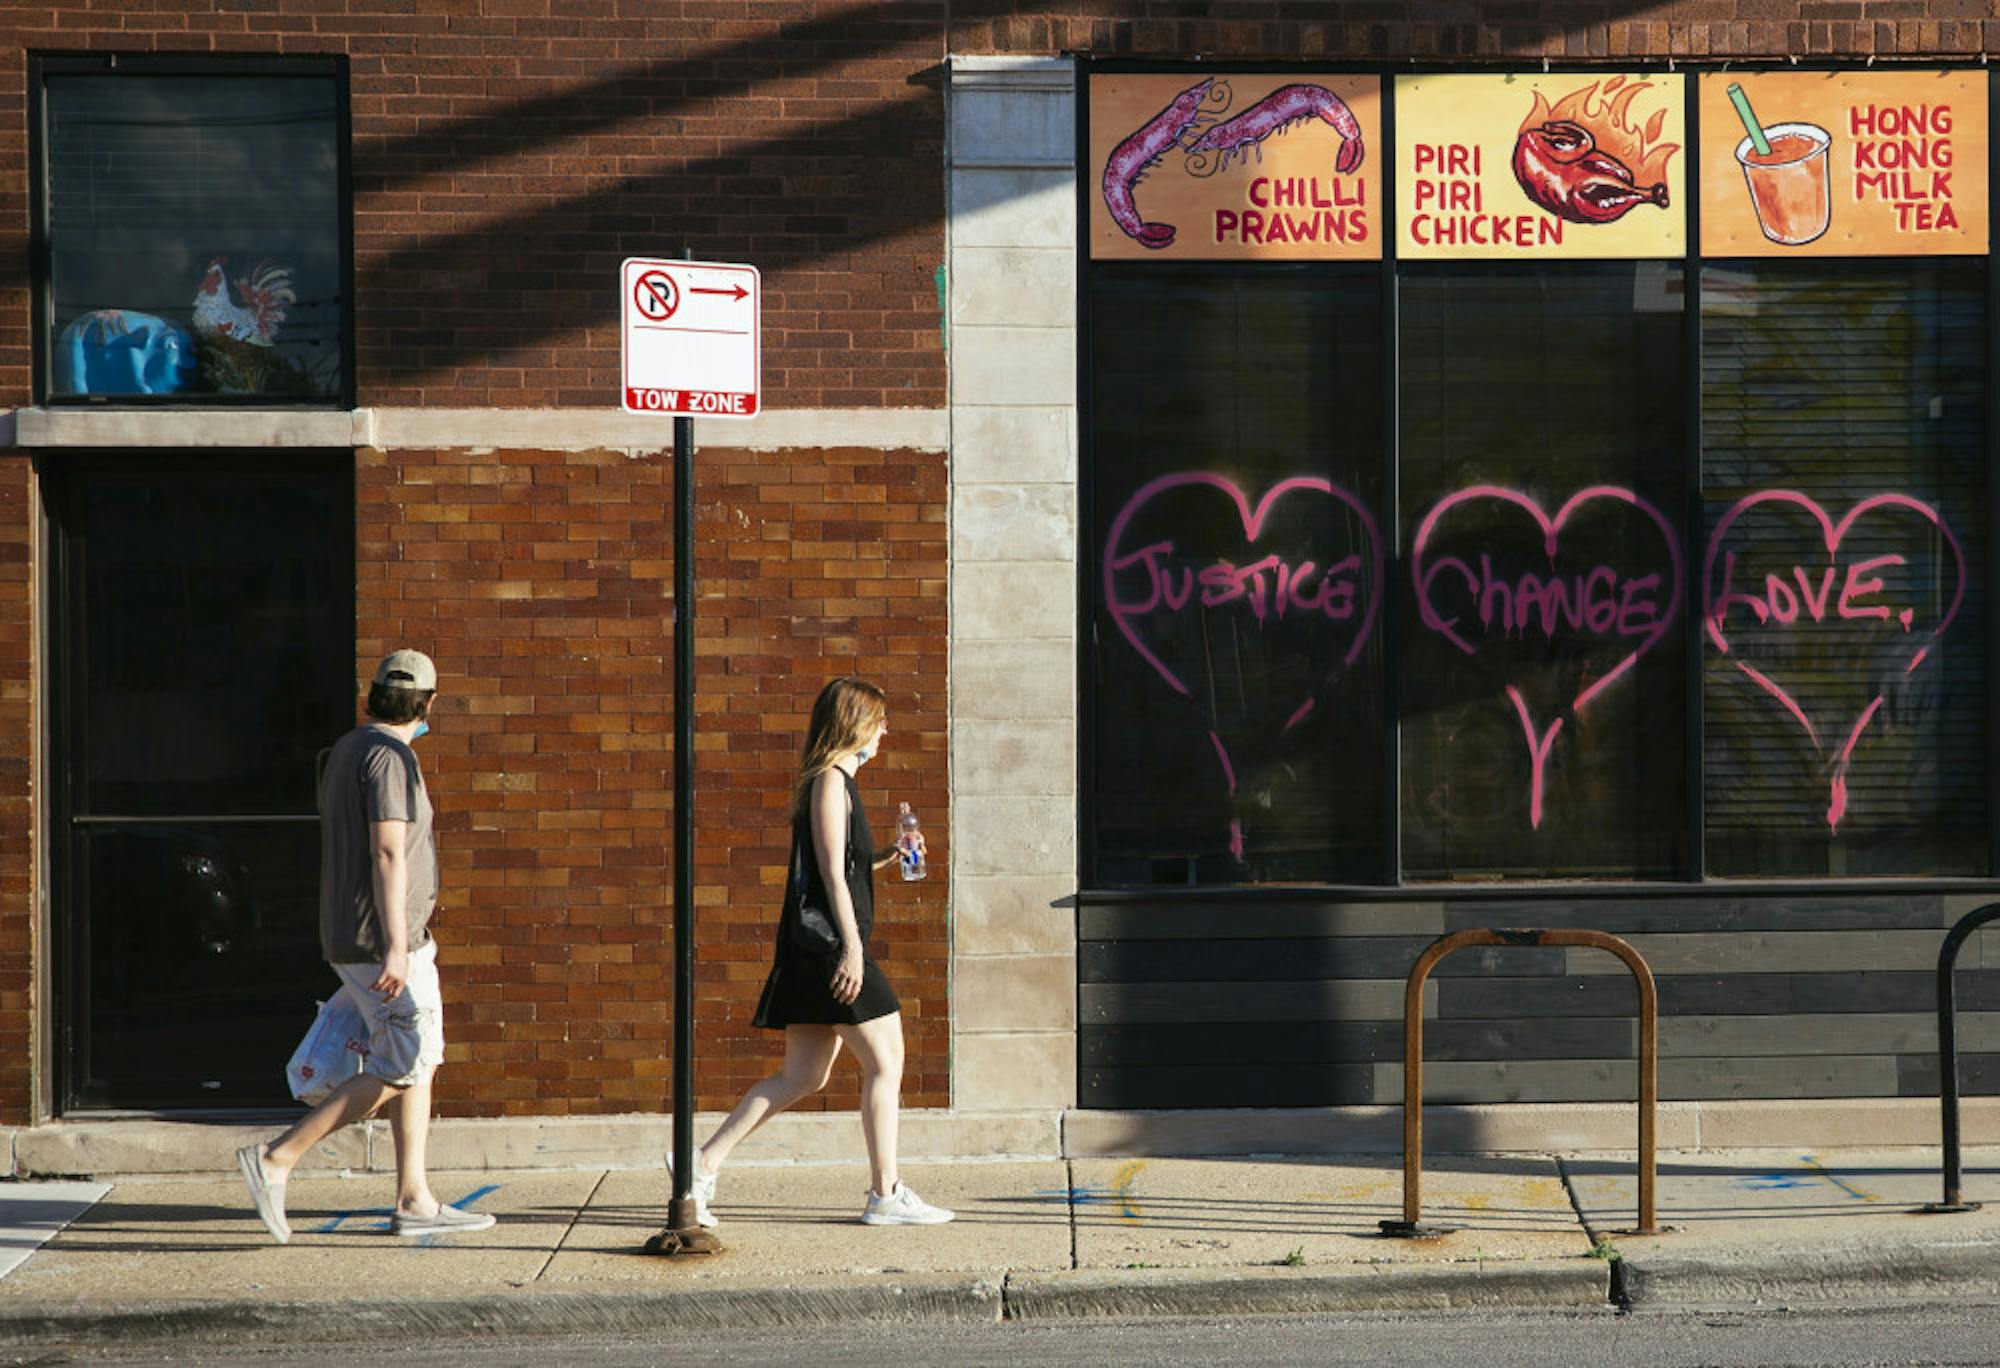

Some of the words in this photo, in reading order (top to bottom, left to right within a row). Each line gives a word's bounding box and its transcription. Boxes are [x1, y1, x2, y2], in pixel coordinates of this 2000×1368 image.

[1850, 104, 1952, 136] HONG
[1415, 144, 1481, 177] PIRI
[1855, 138, 1952, 169] KONG
[1249, 177, 1365, 208] CHILLI
[1415, 179, 1482, 213] PIRI
[1855, 171, 1952, 200] MILK
[1215, 210, 1368, 244] PRAWNS
[1411, 214, 1563, 247] CHICKEN
[1894, 202, 1958, 230] TEA
[632, 389, 679, 409] TOW
[688, 393, 747, 413] ZONE
